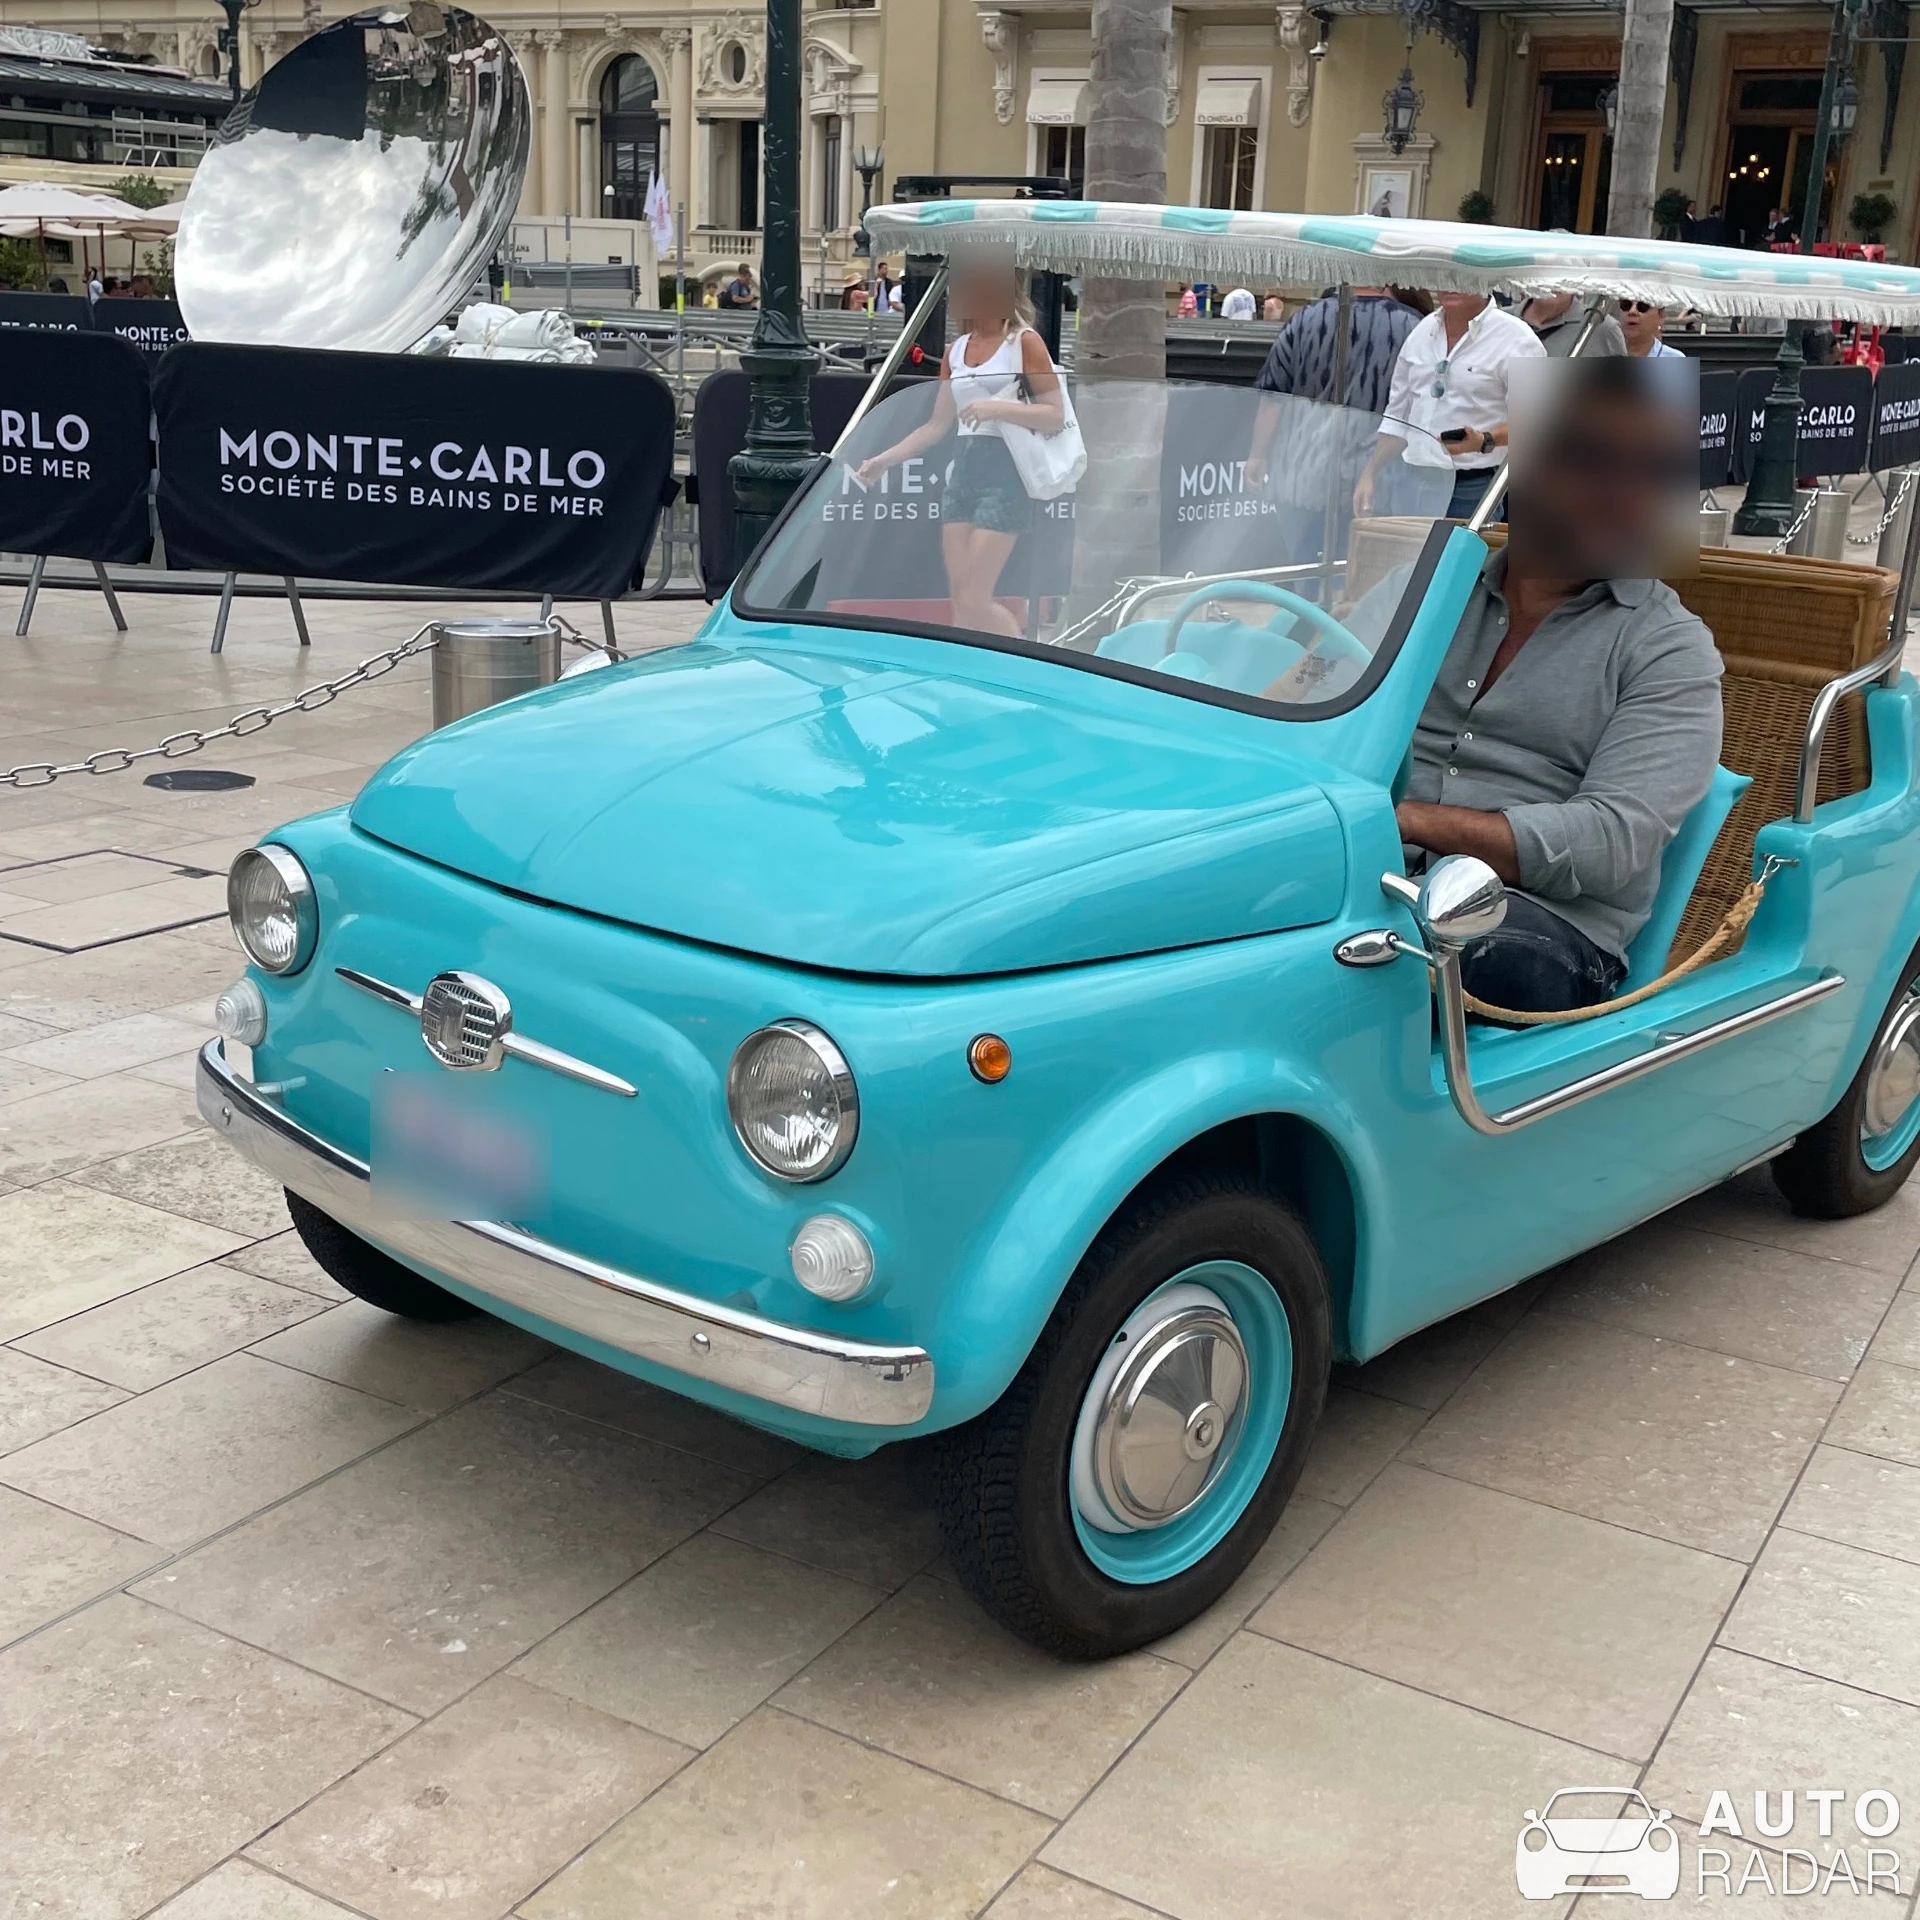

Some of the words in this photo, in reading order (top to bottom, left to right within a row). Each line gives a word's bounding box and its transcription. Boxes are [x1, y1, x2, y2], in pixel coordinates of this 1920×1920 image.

[114, 326, 190, 342] MONTE·C
[152, 342, 168, 351] DES
[1, 409, 90, 452] RLO
[1750, 431, 1762, 443] SO
[1801, 429, 1824, 439] BAINS
[1825, 428, 1836, 438] DE
[2, 455, 32, 475] DE
[42, 458, 91, 480] MER
[221, 474, 335, 500] SOCIÉTÉ
[347, 482, 398, 504] DES
[410, 487, 491, 510] BAINS
[504, 493, 538, 513] DE
[550, 496, 604, 516] MER
[874, 502, 918, 520] DES
[1177, 498, 1231, 522] SOCIÉTÉ
[1234, 500, 1258, 517] DES
